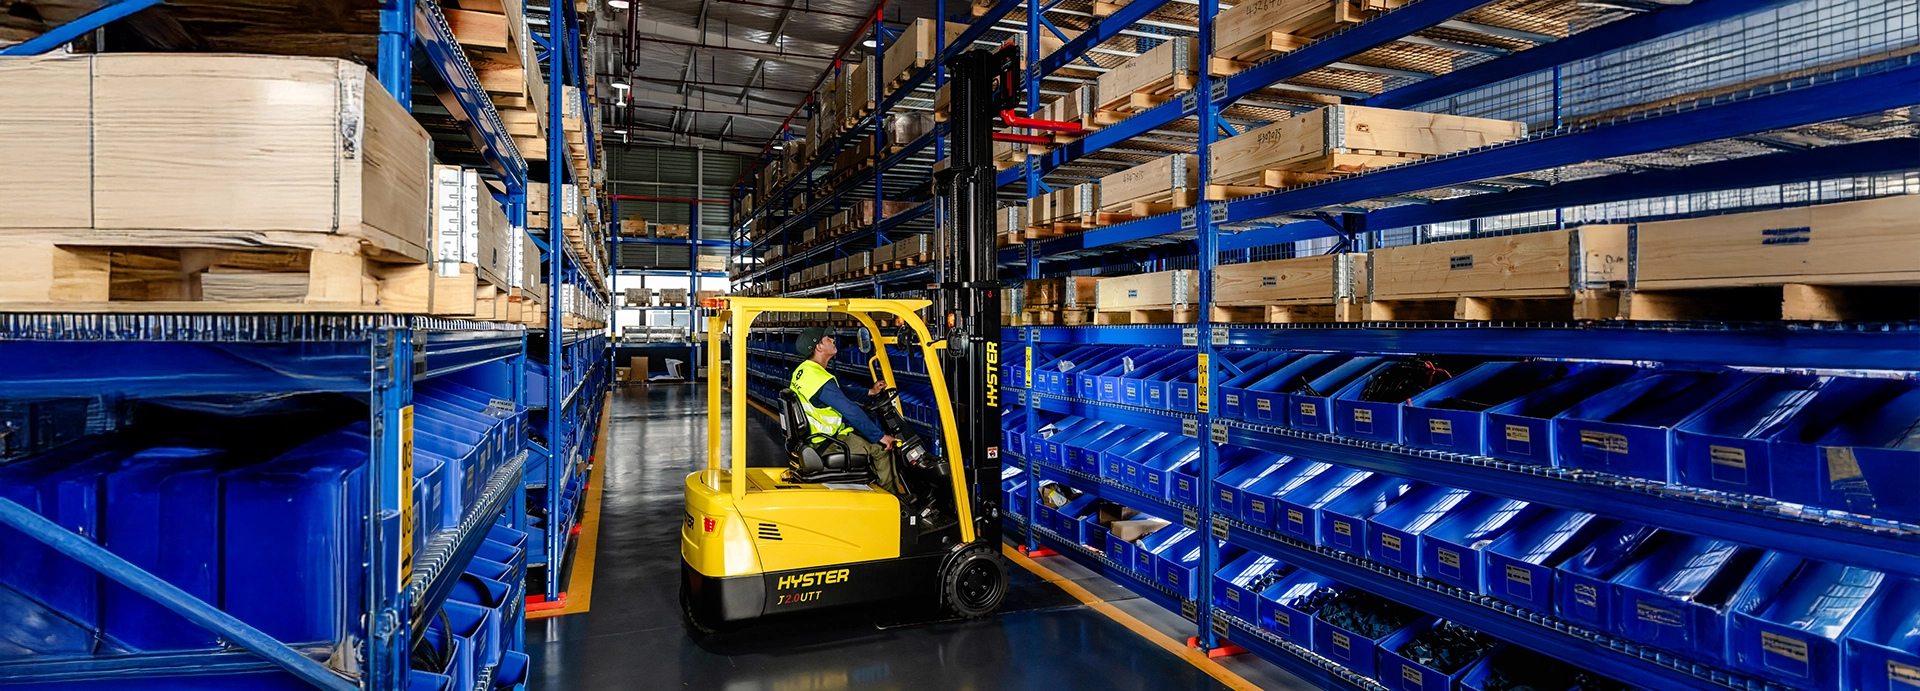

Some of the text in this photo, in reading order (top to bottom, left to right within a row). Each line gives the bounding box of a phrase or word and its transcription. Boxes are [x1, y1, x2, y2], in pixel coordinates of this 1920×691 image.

[986, 341, 998, 407] HYSTER
[1198, 364, 1208, 374] 04
[1198, 386, 1208, 396] 09
[401, 441, 412, 472] 03
[401, 504, 412, 538] 08
[777, 568, 850, 591] HYSTER
[777, 590, 822, 605] J2.0UTT
